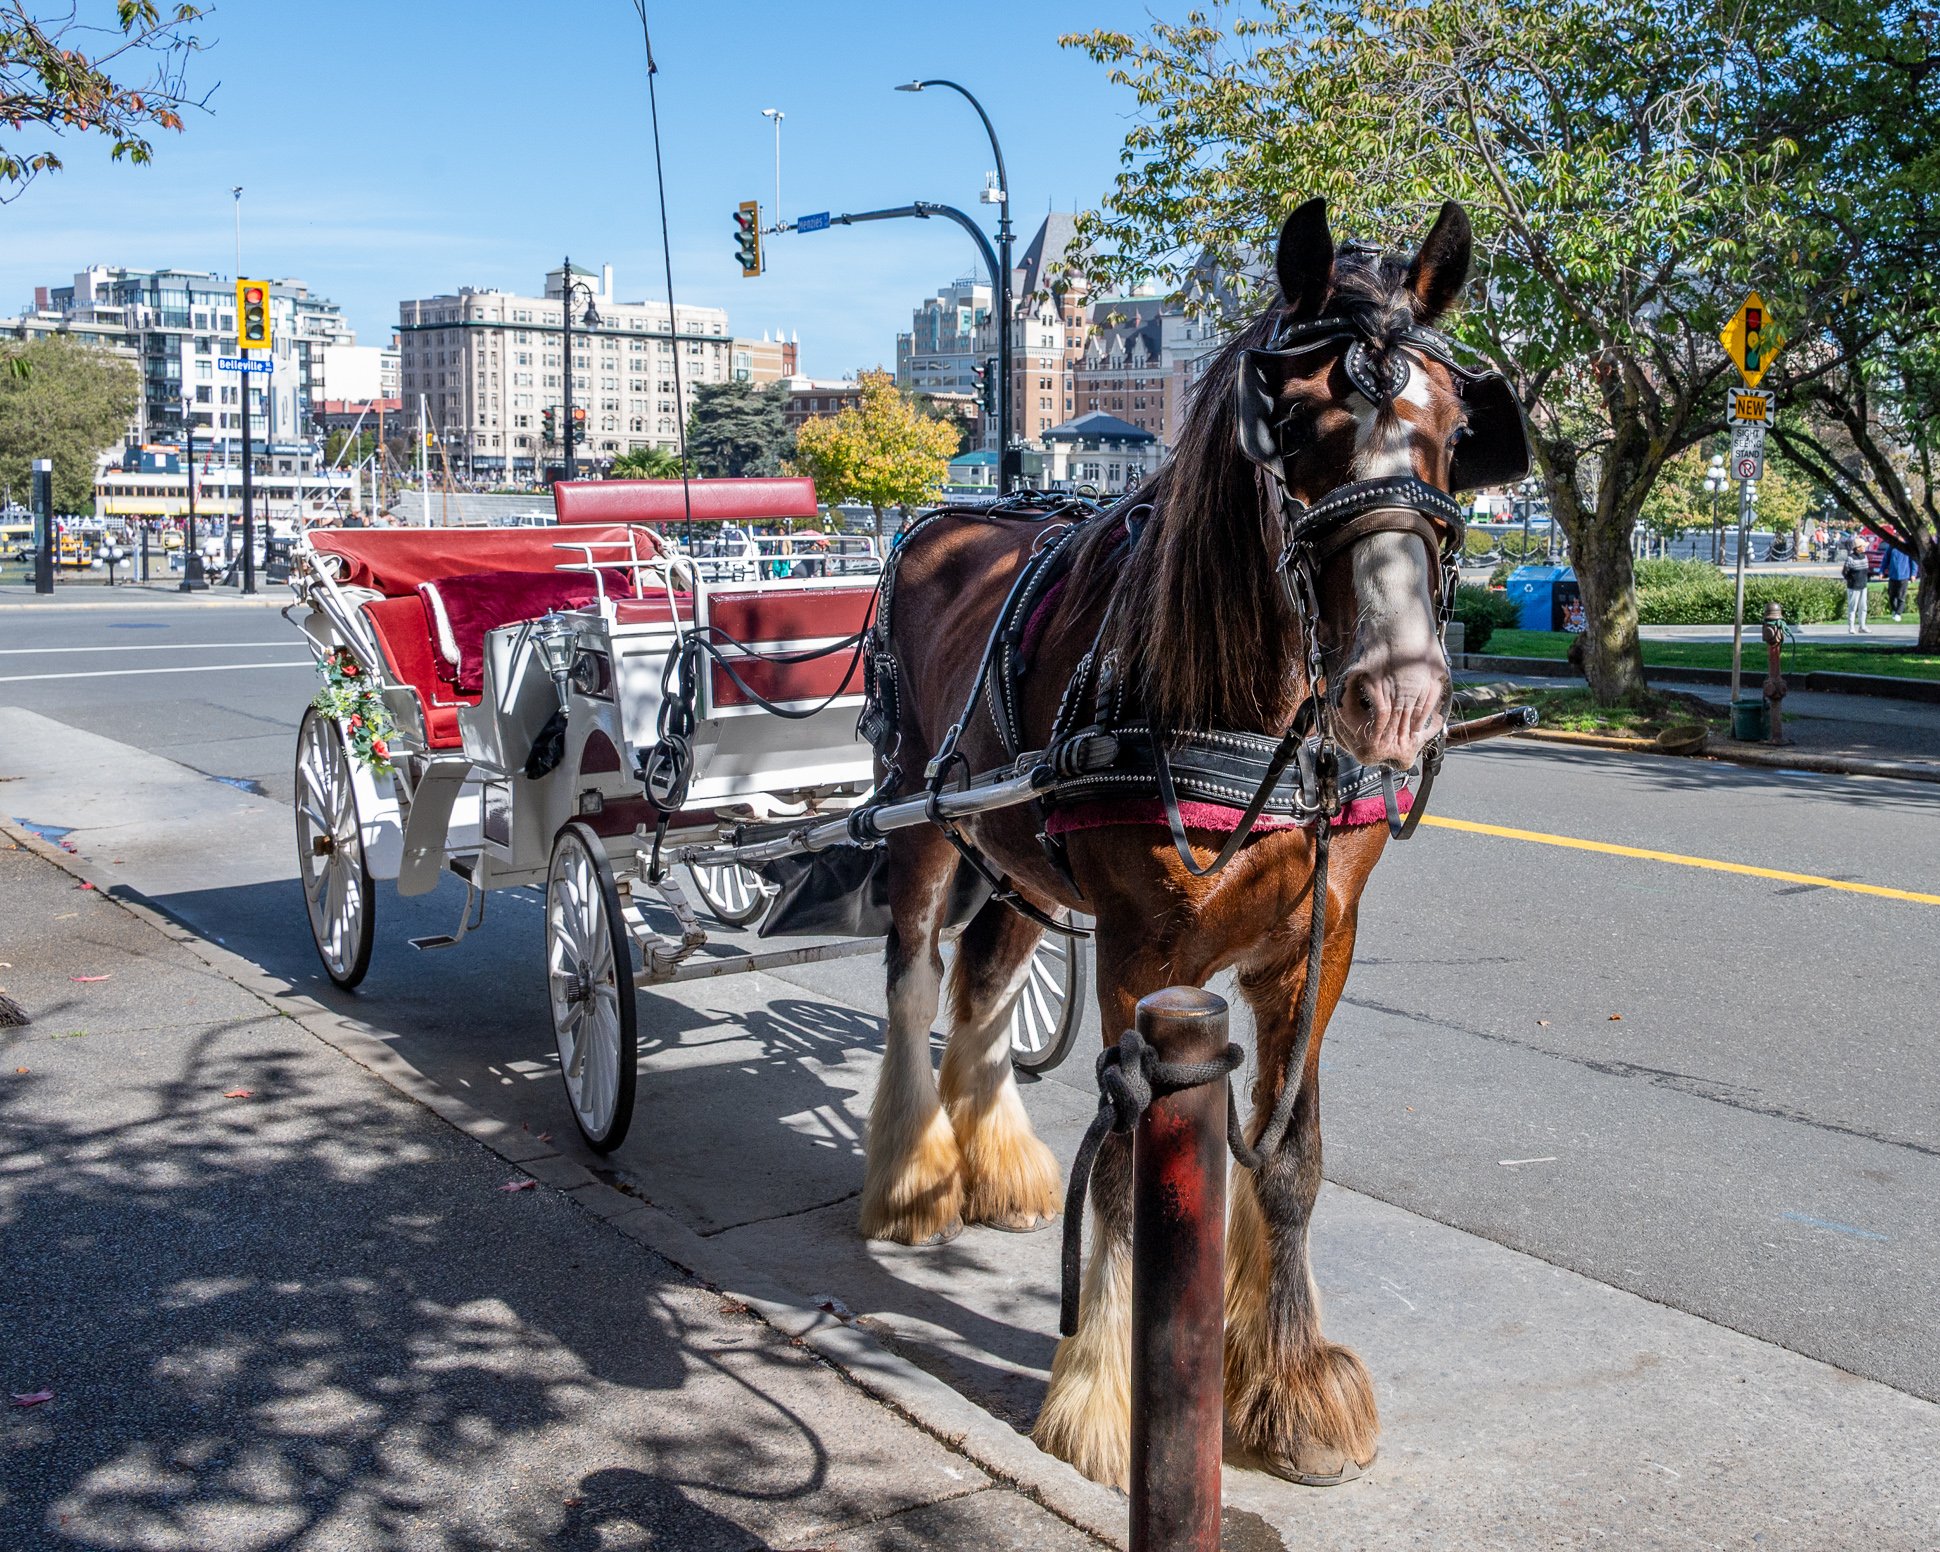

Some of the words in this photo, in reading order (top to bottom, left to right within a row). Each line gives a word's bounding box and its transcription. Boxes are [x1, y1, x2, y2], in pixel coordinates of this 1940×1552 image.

[219, 360, 263, 371] Belleville
[1737, 399, 1765, 416] NEW
[1737, 429, 1760, 438] SIGHT
[1734, 440, 1762, 448] SEEING
[1735, 450, 1760, 458] STAND
